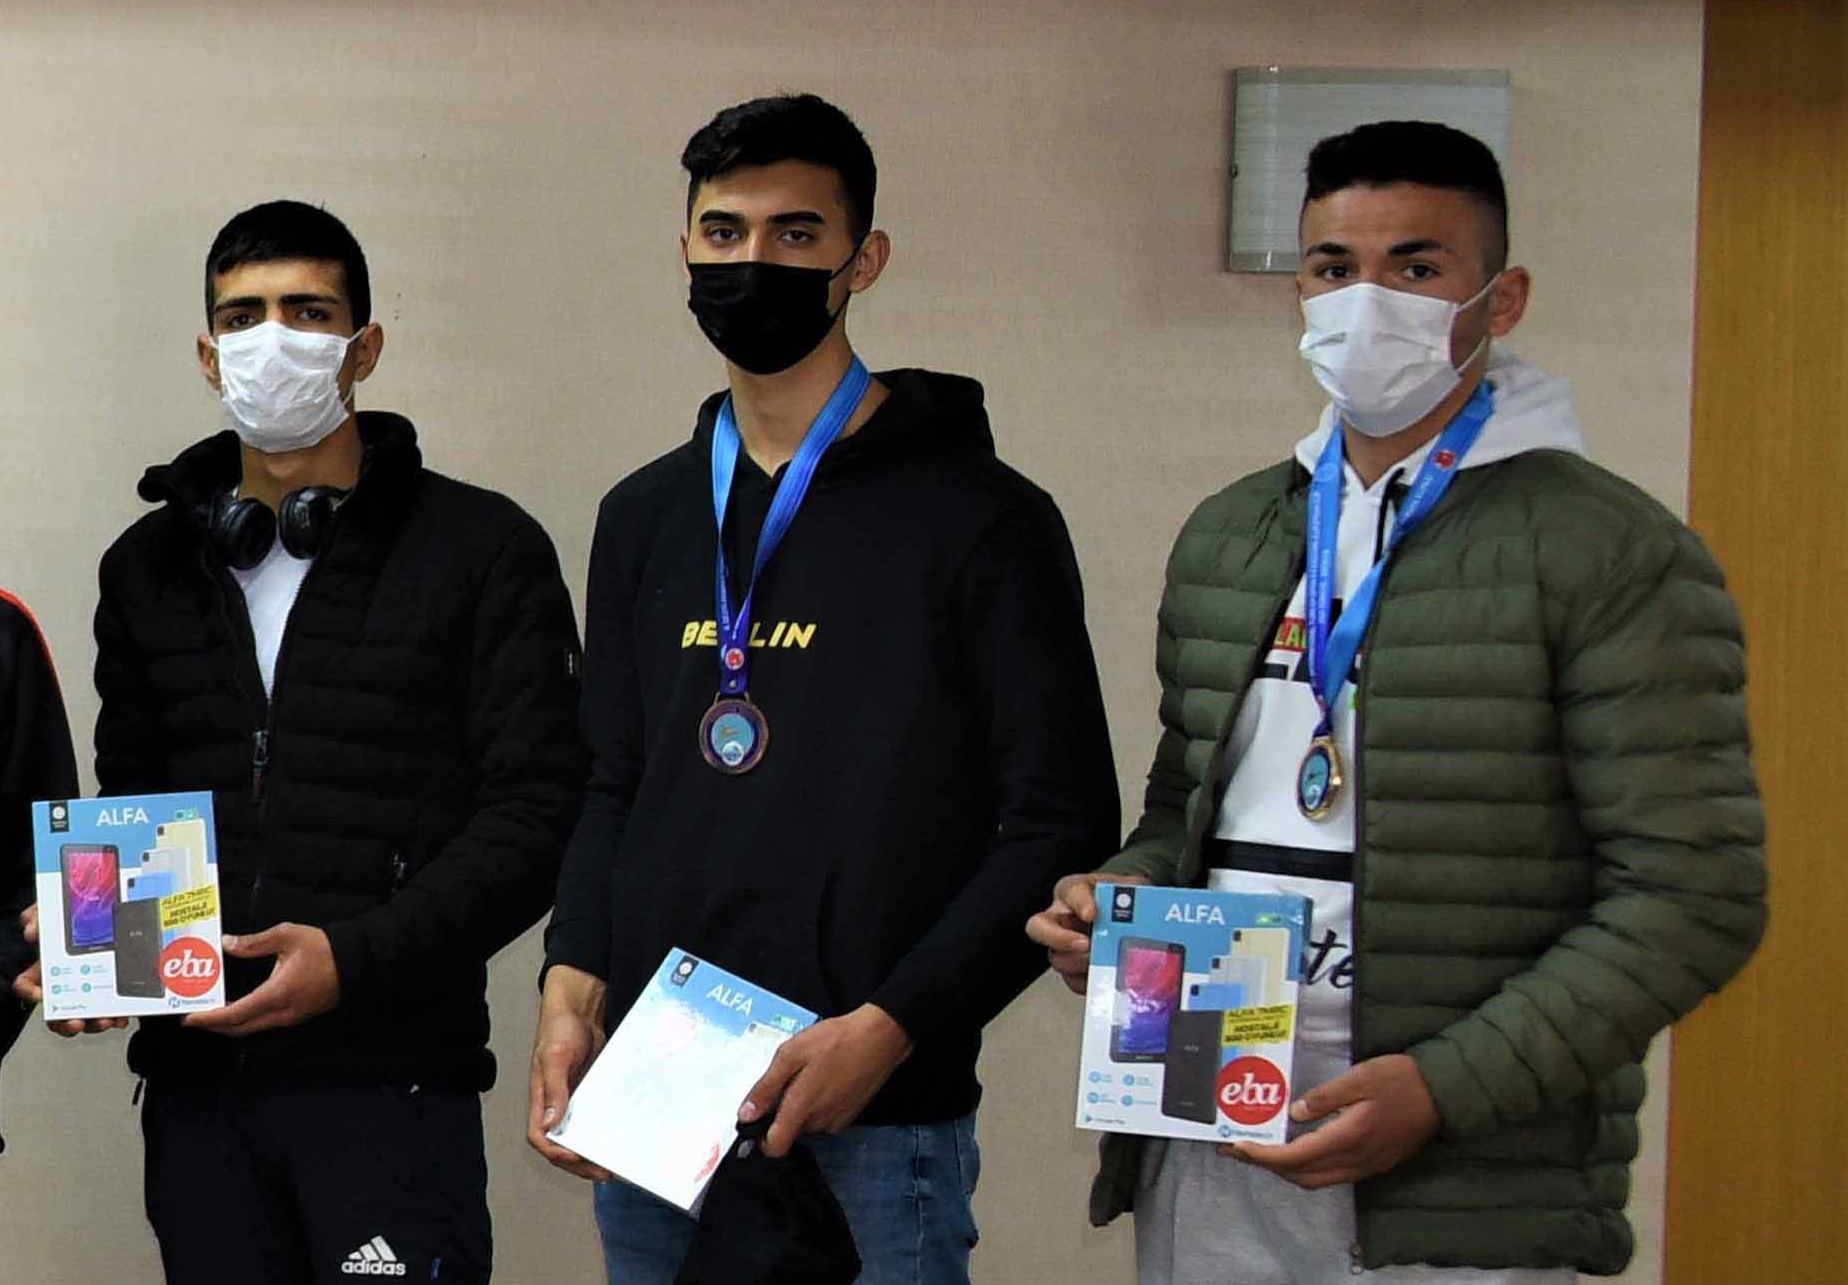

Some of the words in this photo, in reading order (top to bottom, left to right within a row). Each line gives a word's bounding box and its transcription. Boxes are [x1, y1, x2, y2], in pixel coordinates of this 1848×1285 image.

[681, 620, 817, 650] BELIN
[96, 808, 150, 827] ALFA
[1164, 903, 1226, 926] ALFA
[164, 949, 216, 978] eba
[706, 983, 754, 1017] ALFA
[1221, 1072, 1283, 1104] eba
[341, 1259, 406, 1277] adidas
